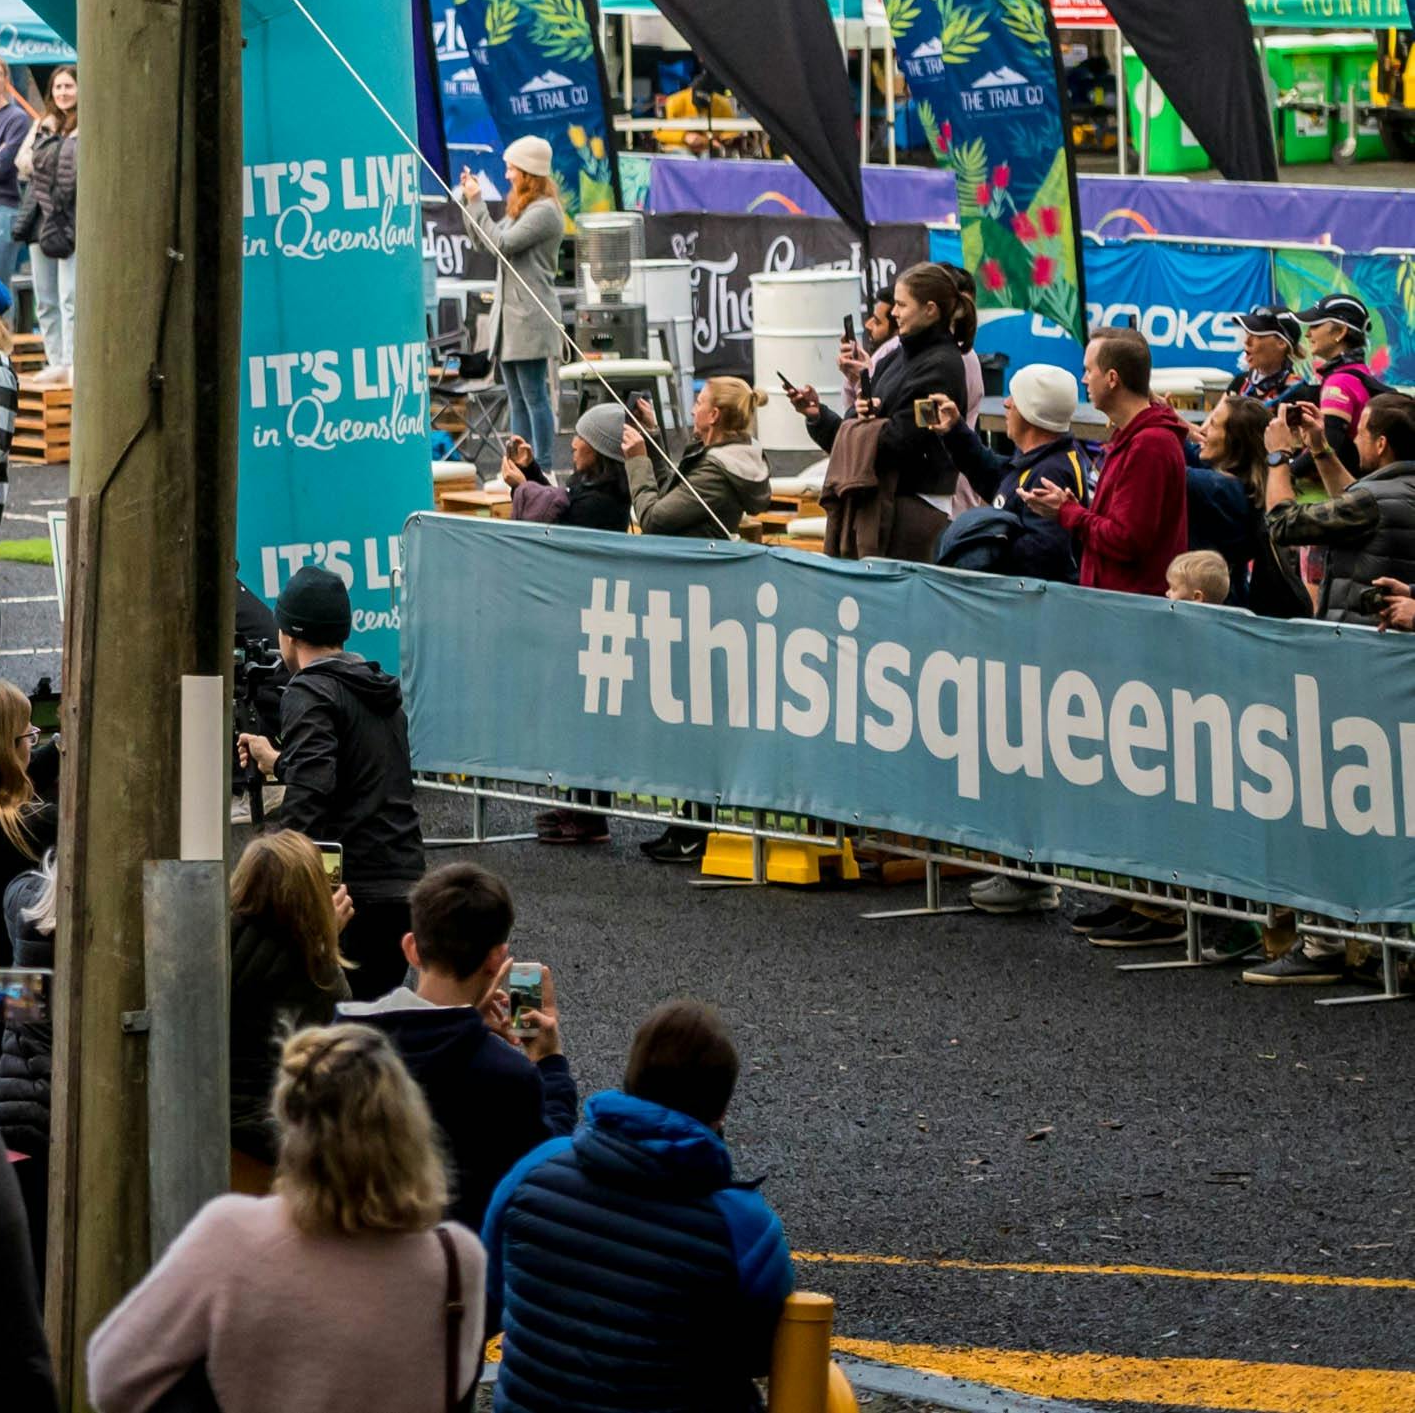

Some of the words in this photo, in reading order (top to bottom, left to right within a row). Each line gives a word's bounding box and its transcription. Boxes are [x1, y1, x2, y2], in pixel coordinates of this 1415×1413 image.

[509, 94, 533, 116] THE
[537, 88, 569, 111] TRAIL
[960, 91, 985, 112] THE
[988, 87, 1023, 110] TRAIL
[1025, 85, 1044, 105] CO
[242, 159, 330, 218] IT'S
[242, 234, 269, 257] in
[274, 195, 417, 260] Queensland
[248, 349, 343, 409] IT'S
[252, 425, 282, 448] in
[286, 383, 426, 451] Queensland
[260, 539, 354, 599] IT'S
